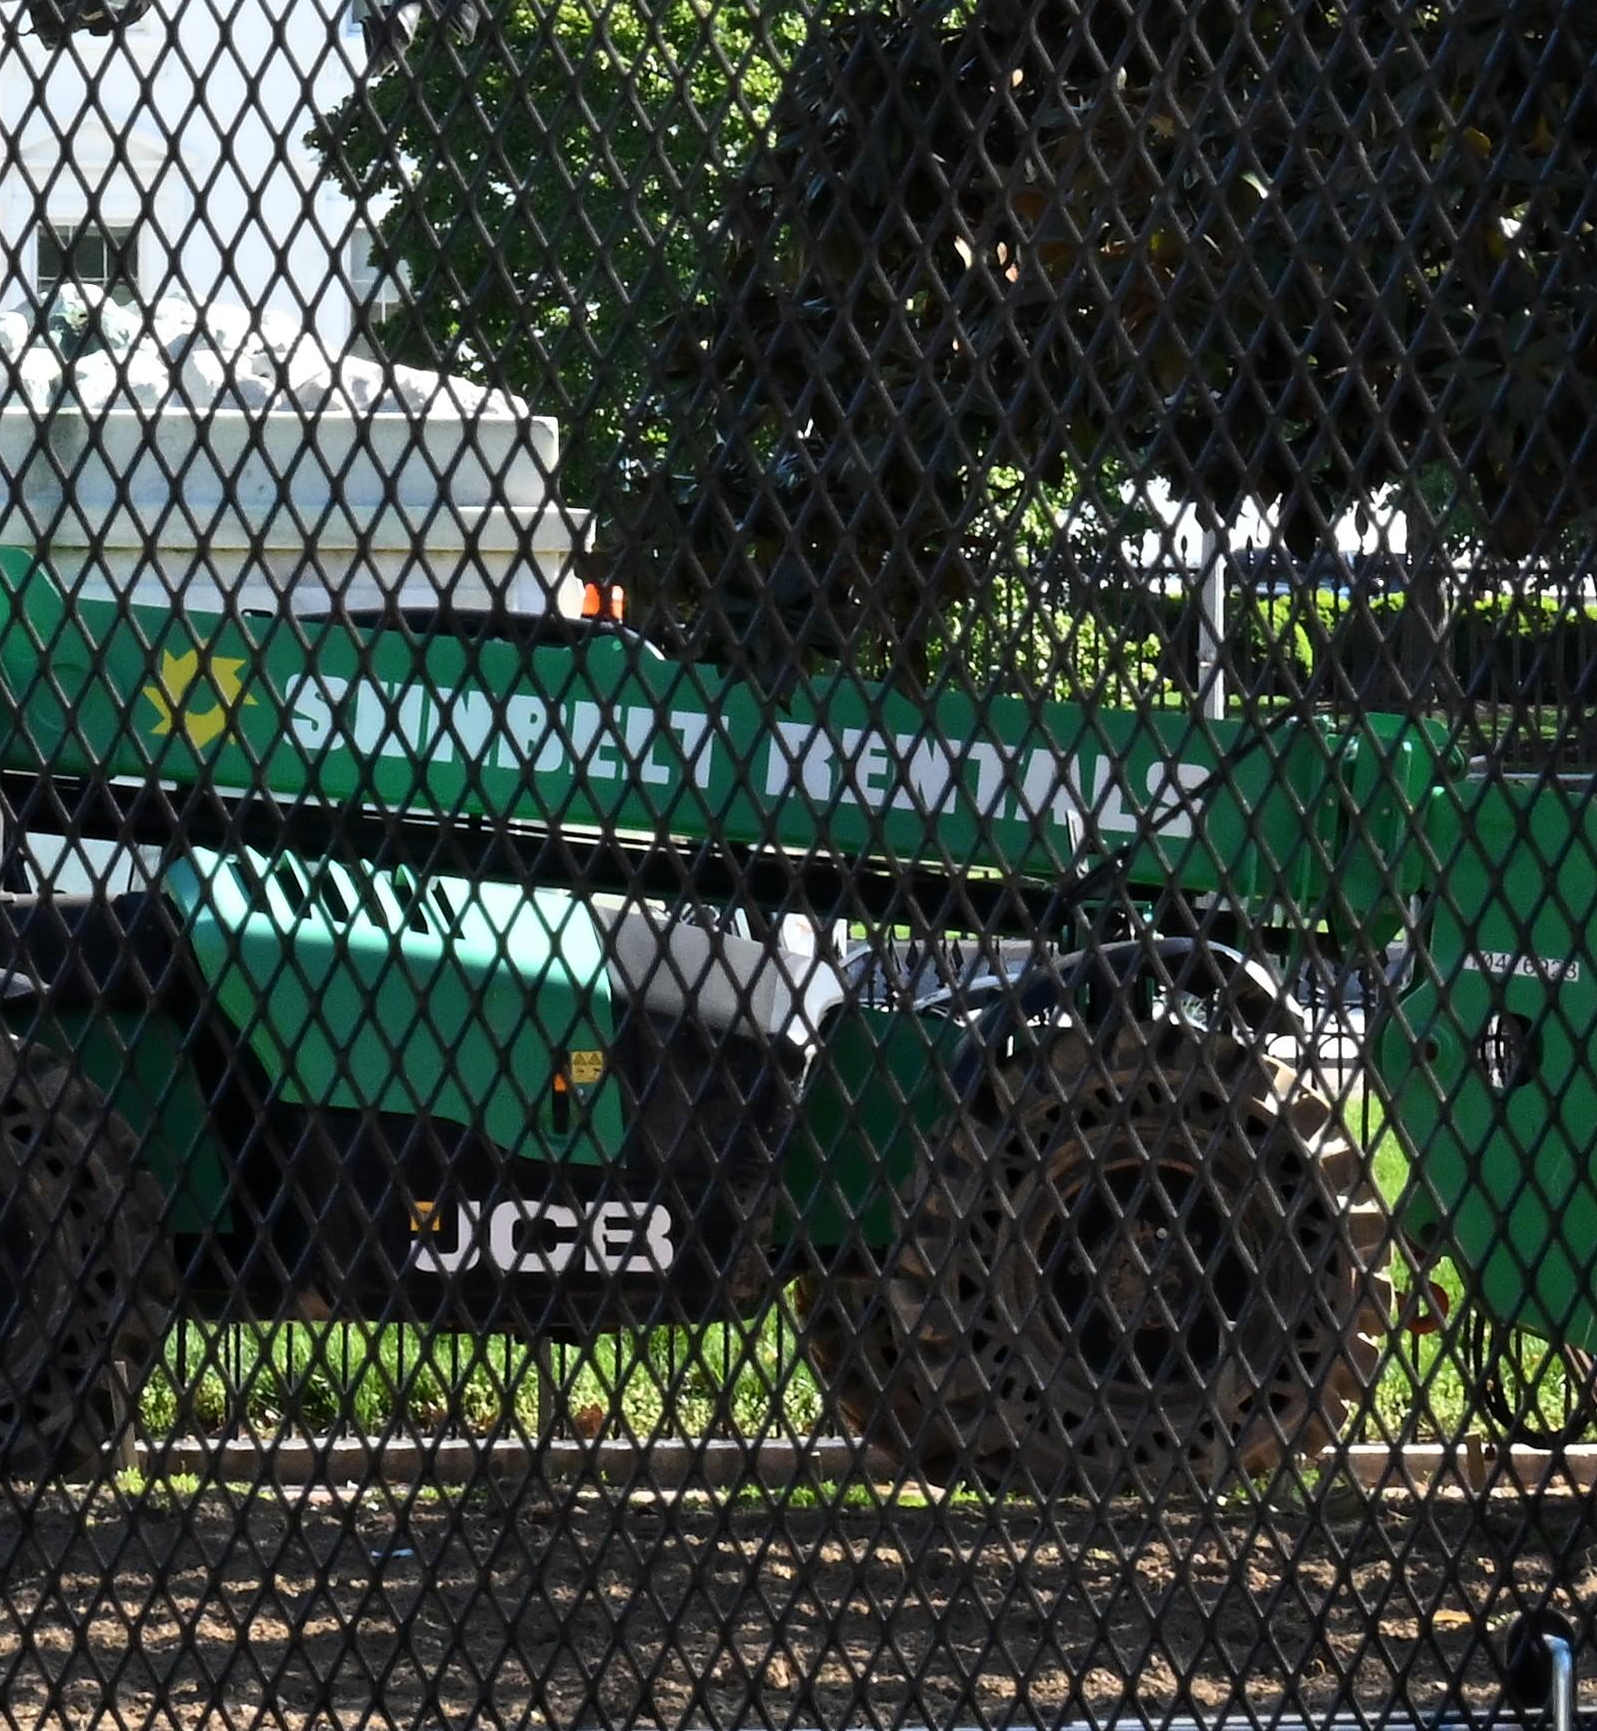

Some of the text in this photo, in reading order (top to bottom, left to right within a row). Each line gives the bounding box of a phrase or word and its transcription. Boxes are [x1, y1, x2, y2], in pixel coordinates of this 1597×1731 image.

[284, 672, 1211, 838] SUNBELT RENTALS
[409, 1200, 675, 1272] JCB
